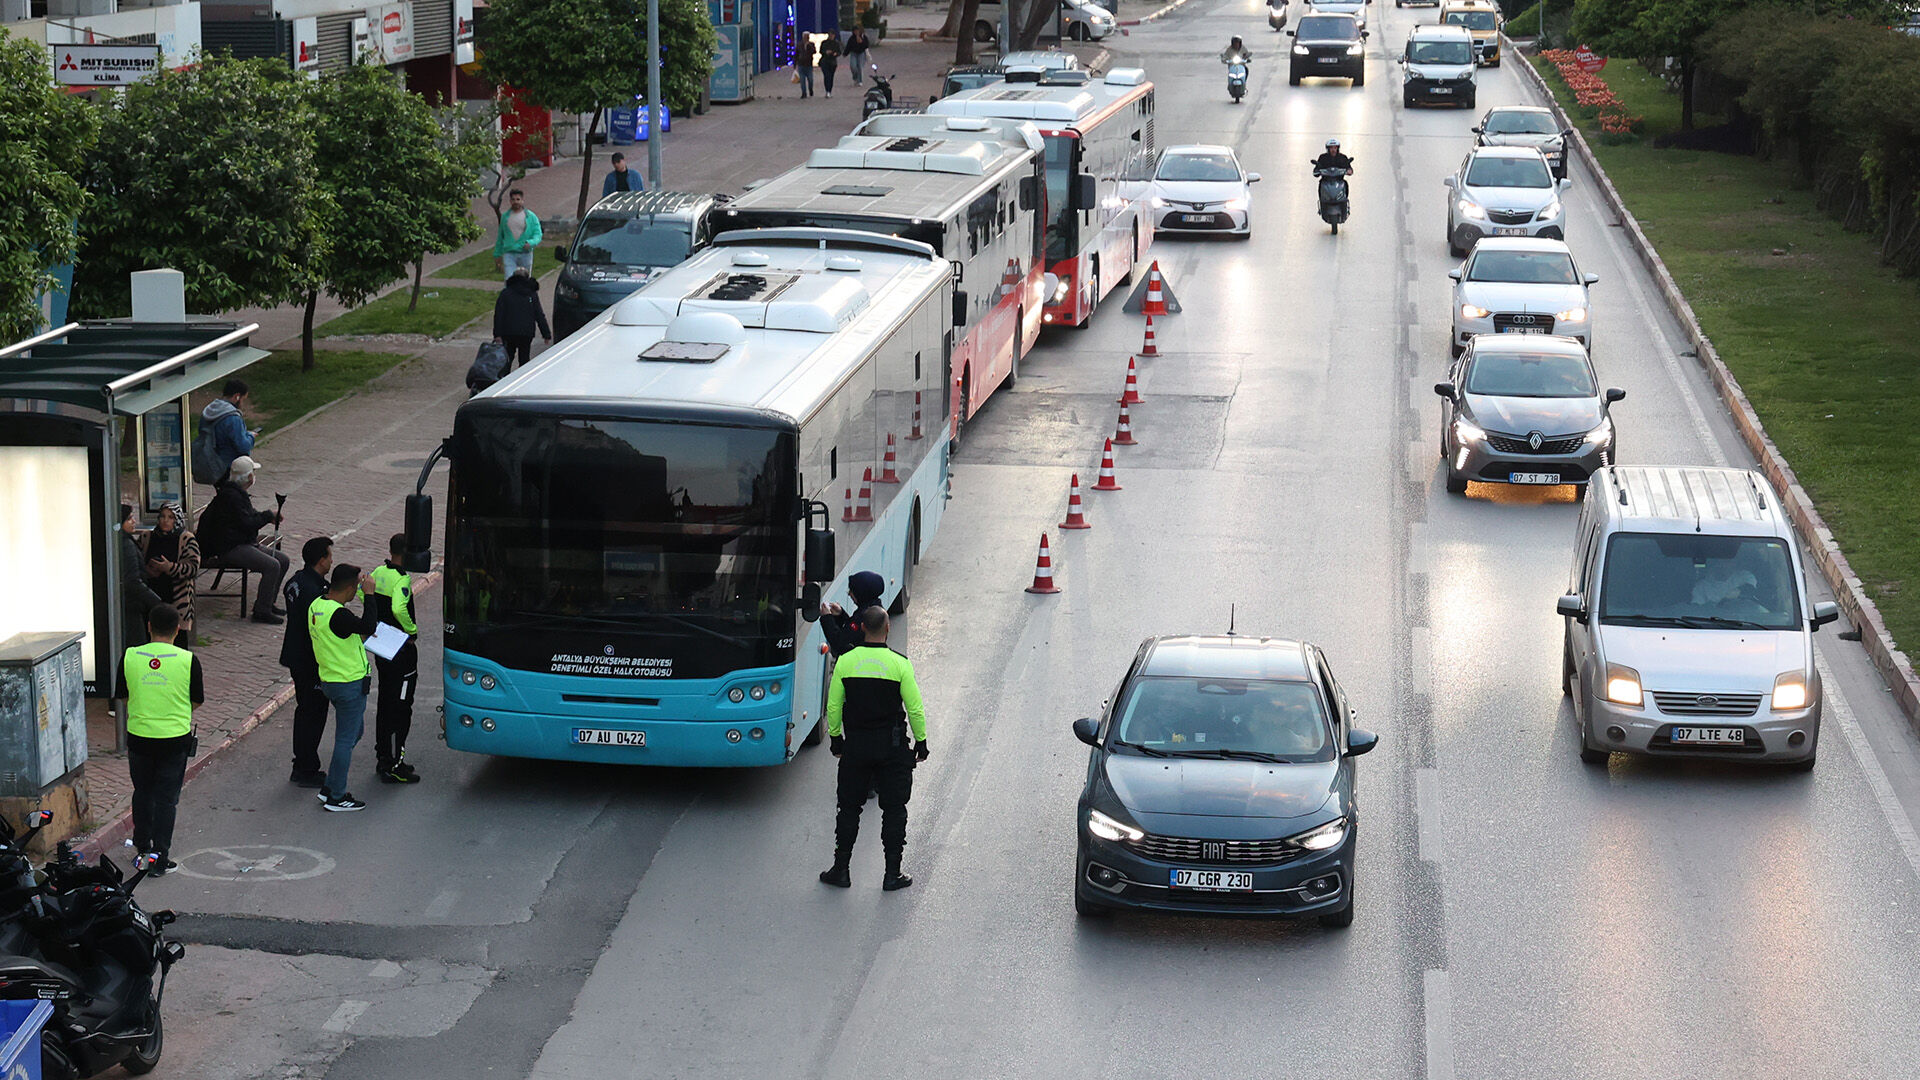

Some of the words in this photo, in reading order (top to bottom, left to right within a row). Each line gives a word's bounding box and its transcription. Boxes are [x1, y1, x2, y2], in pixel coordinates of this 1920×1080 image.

[81, 58, 155, 66] MITSUBISHI
[94, 73, 120, 81] KLİMA
[1513, 474, 1523, 482] 07
[1528, 474, 1538, 482] ST
[1544, 475, 1559, 483] 738
[776, 638, 793, 648] 422
[551, 654, 583, 663] ANTALYA
[584, 655, 631, 666] BÜYÜKŞEHİR
[631, 658, 673, 667] BELEDİYESİ
[551, 664, 592, 673] DENETİMLİ
[593, 665, 612, 675] ÖZEL
[613, 667, 633, 676] HALK
[634, 667, 673, 677] OTOBÜSÜ
[580, 730, 593, 742] 07
[597, 731, 611, 743] AU
[617, 732, 644, 745] 0422
[1678, 729, 1692, 740] 07
[1700, 729, 1720, 740] LTE
[1728, 730, 1742, 741] 48
[1203, 842, 1226, 859] FIAT
[1177, 871, 1192, 885] 07
[1198, 872, 1221, 887] CGR
[1227, 874, 1251, 888] 230
